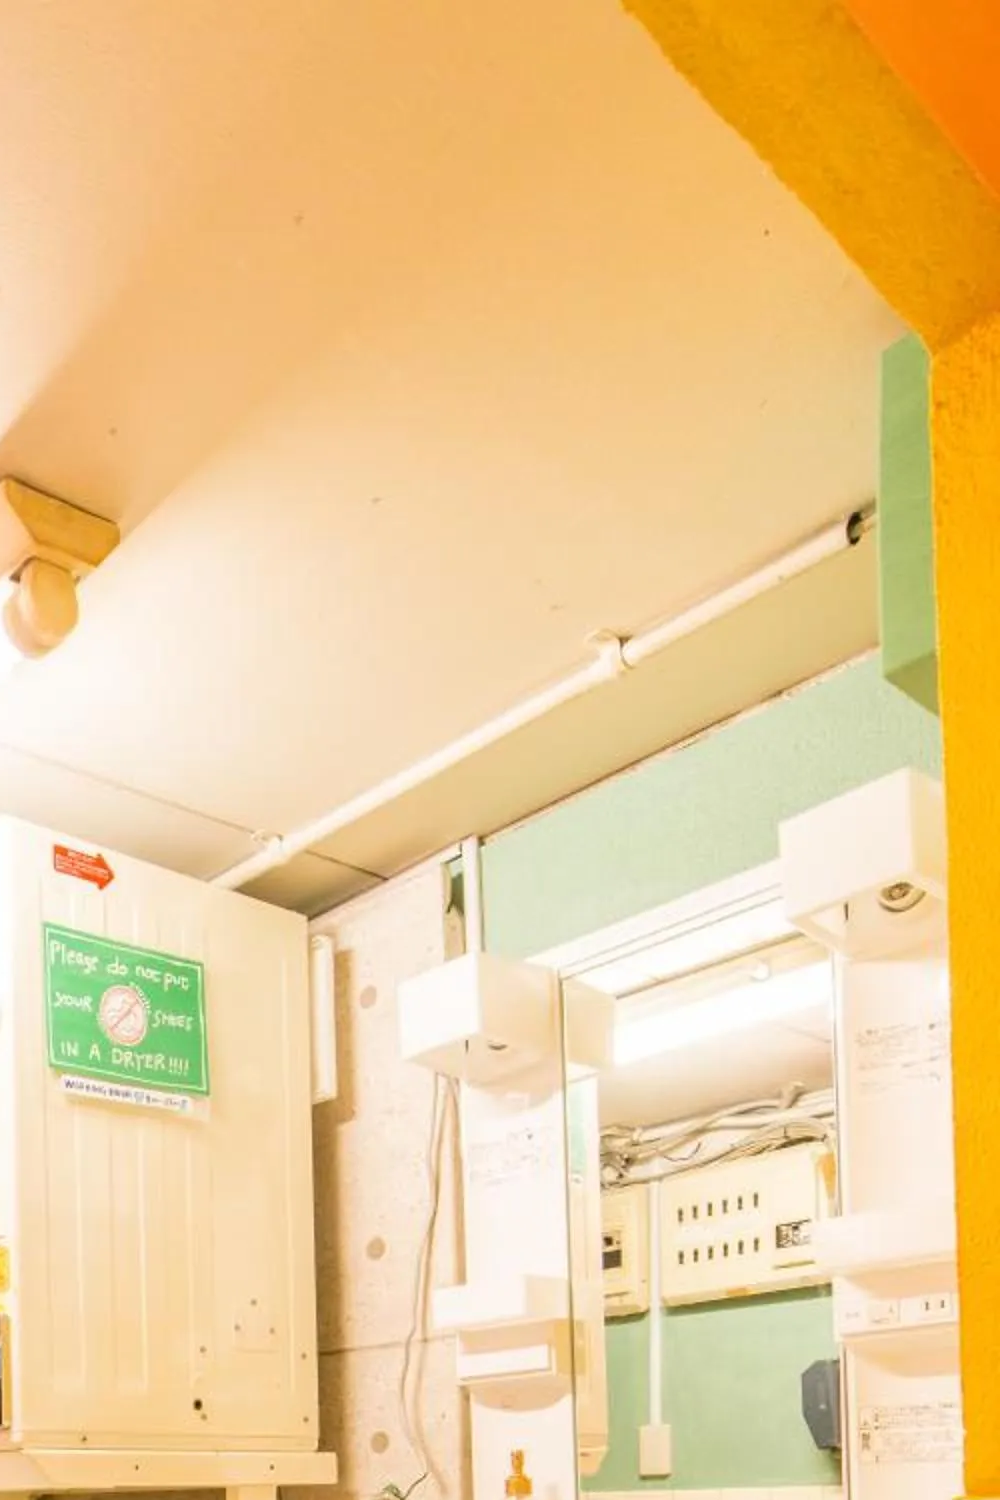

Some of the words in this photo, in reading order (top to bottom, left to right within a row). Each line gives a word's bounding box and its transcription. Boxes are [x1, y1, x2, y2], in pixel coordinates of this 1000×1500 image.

[50, 939, 99, 974] Please
[107, 956, 129, 976] do
[135, 965, 161, 983] not
[152, 1009, 195, 1033] SHOES
[61, 1040, 80, 1058] IN
[88, 1042, 101, 1061] A
